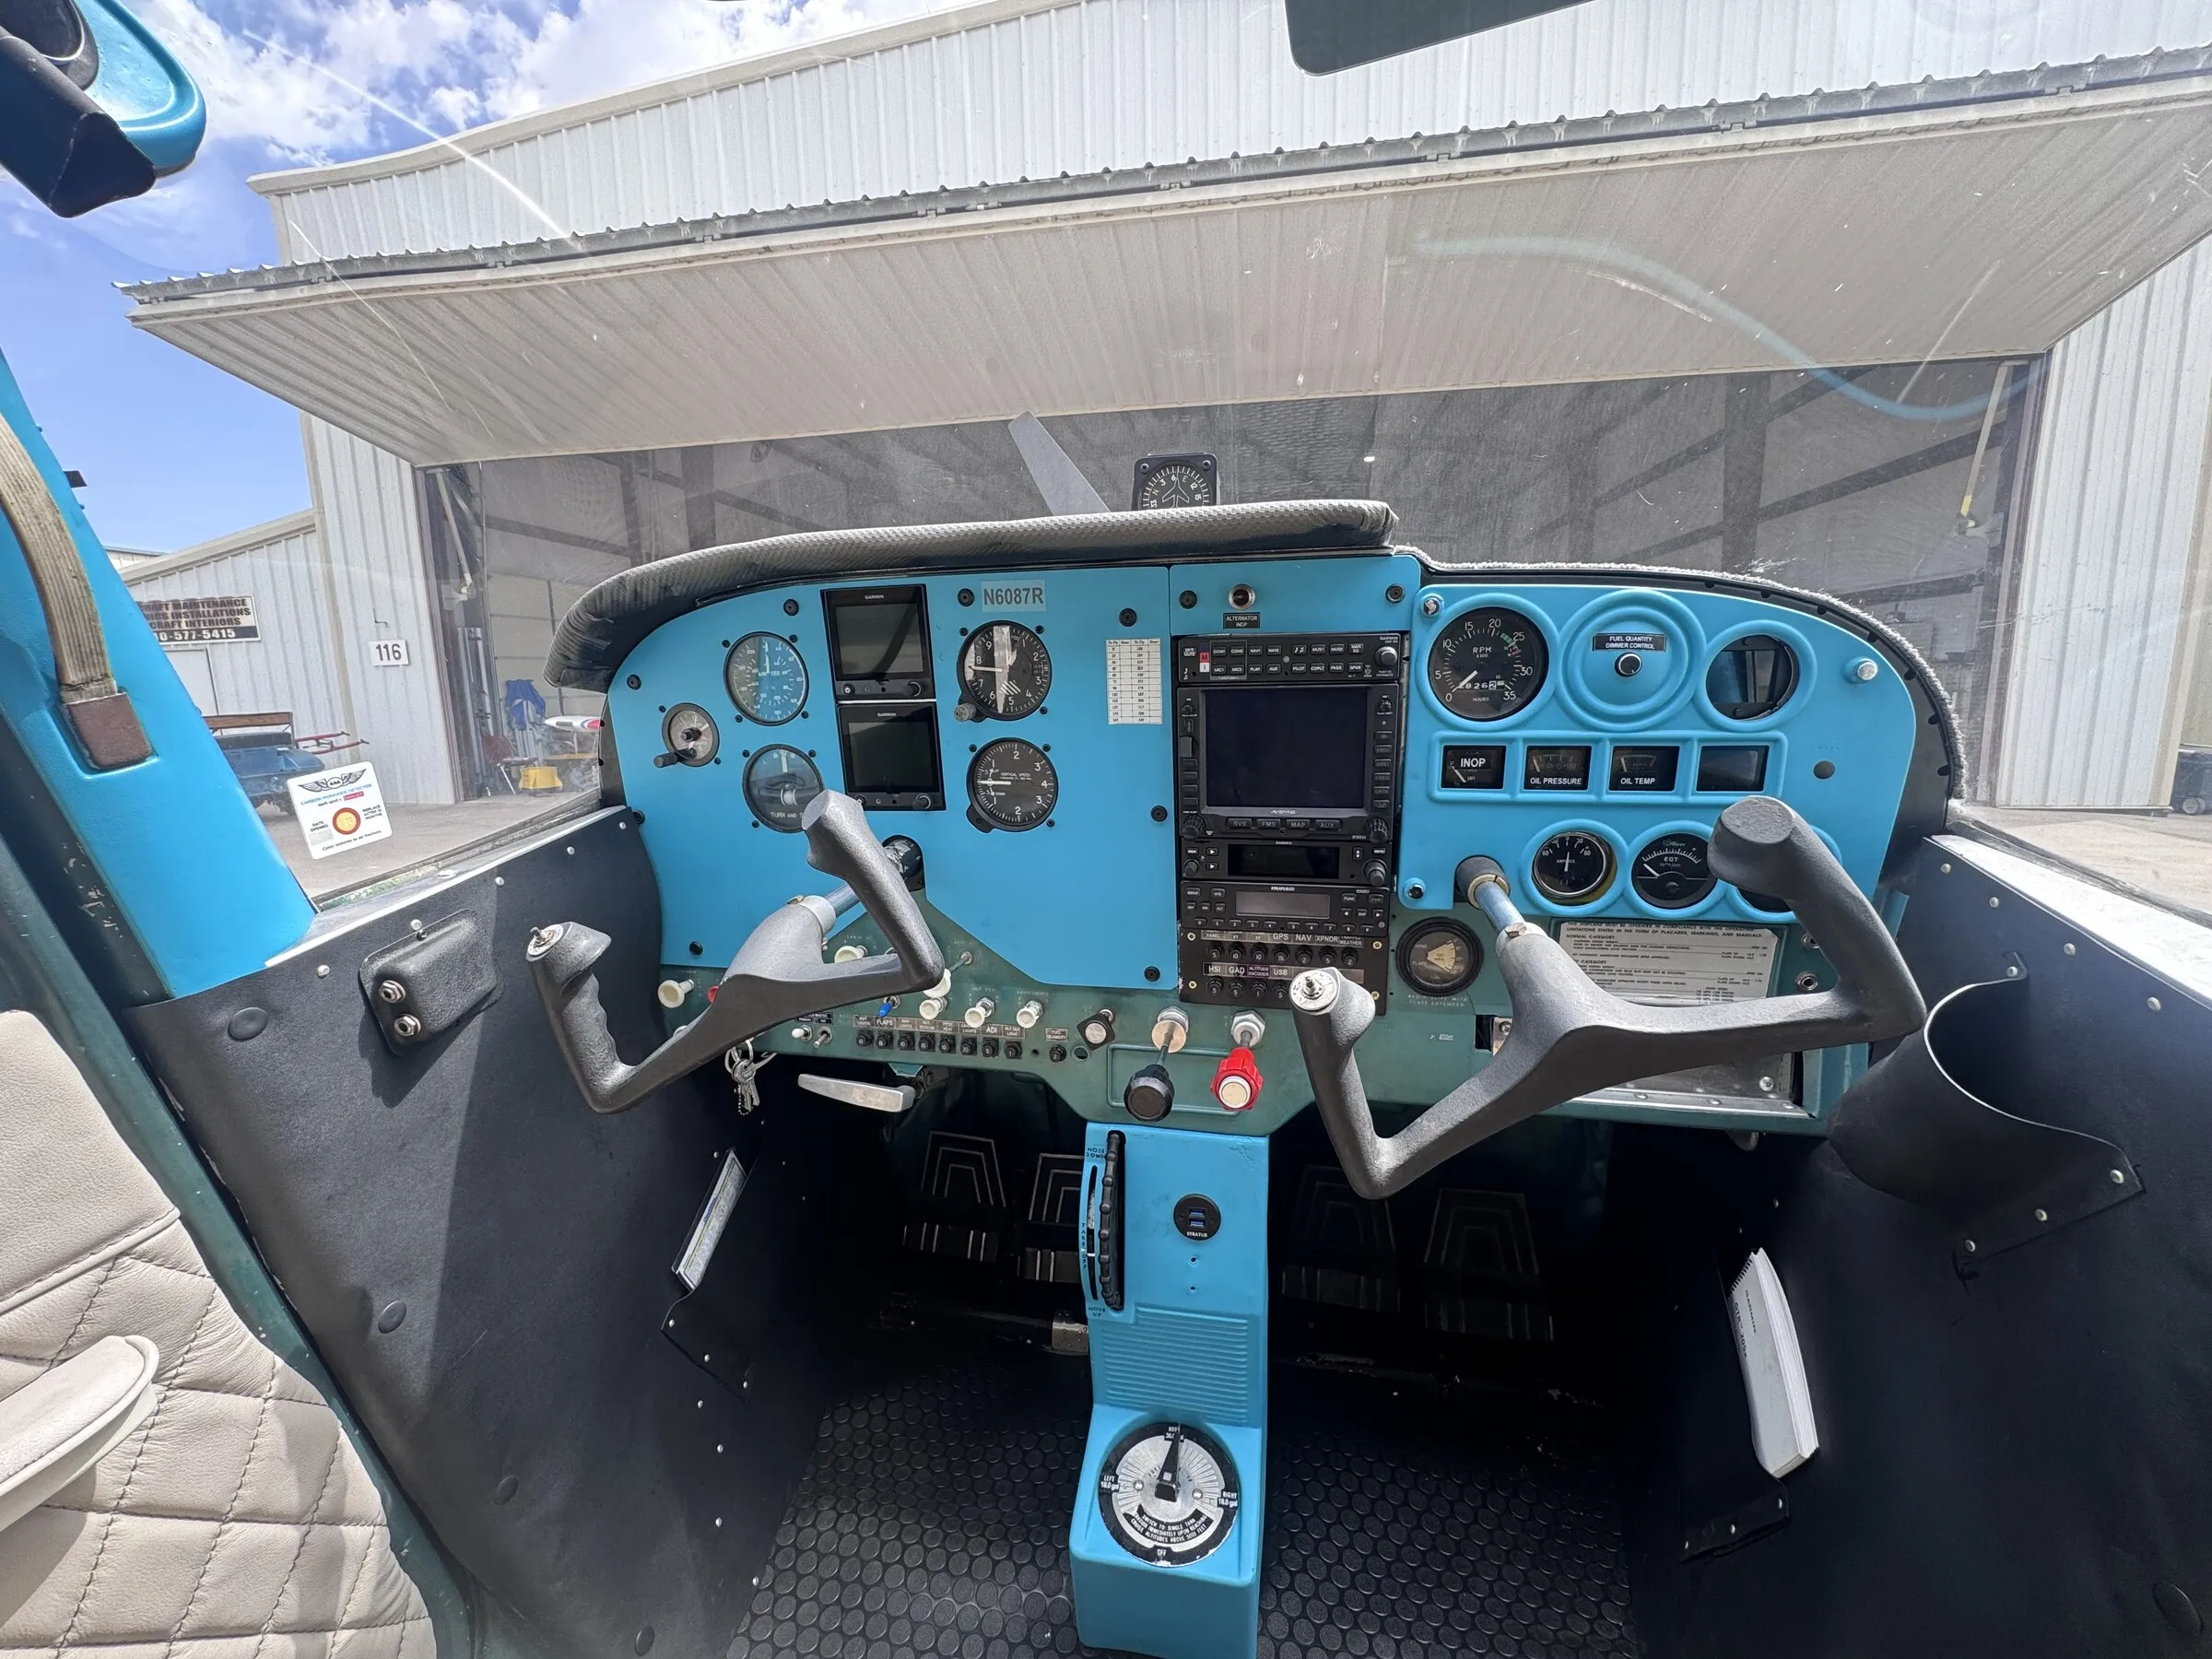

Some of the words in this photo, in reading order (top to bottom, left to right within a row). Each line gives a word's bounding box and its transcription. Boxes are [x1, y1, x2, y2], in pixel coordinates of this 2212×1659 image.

[983, 587, 1043, 606] N6087R
[171, 599, 248, 611] MAINTENANCE
[171, 607, 252, 620] INSTALLATIONS
[149, 620, 182, 629] CRAFT
[184, 618, 241, 629] INTERIORS
[1465, 621, 1474, 631] 15
[1488, 618, 1501, 628] 20
[1512, 631, 1525, 641] 25
[985, 641, 993, 650] 9
[1442, 639, 1452, 648] 10
[375, 643, 402, 662] 116
[1032, 653, 1039, 661] 2
[1435, 670, 1442, 680] 5
[1520, 666, 1533, 677] 30
[1035, 677, 1041, 685] 3
[989, 691, 996, 700] 6
[1025, 689, 1032, 698] 4
[1445, 693, 1453, 701] 0
[1503, 691, 1516, 700] 35
[1008, 697, 1015, 706] 5
[1013, 750, 1020, 759] 2
[1033, 762, 1041, 771] 3
[1460, 758, 1487, 768] INOP
[1041, 780, 1048, 788] 4
[1543, 777, 1583, 785] PRESSURE
[1620, 777, 1633, 785] OIL
[1634, 777, 1655, 785] TEMP
[300, 796, 323, 806] CARBON
[1036, 795, 1042, 804] 3
[1015, 806, 1021, 815] 2
[1229, 966, 1245, 974] GAD
[1143, 1514, 1158, 1527] SWITCH
[1184, 1518, 1196, 1527] TANK
[1147, 1525, 1177, 1536] IMMEDIATELY
[1177, 1528, 1190, 1536] UPON
[1189, 1514, 1207, 1531] REACHING
[1130, 1518, 1145, 1534] CRUISE
[1145, 1531, 1169, 1543] ALTITUDES
[1196, 1524, 1207, 1534] FEET
[1157, 1548, 1167, 1557] OFF
